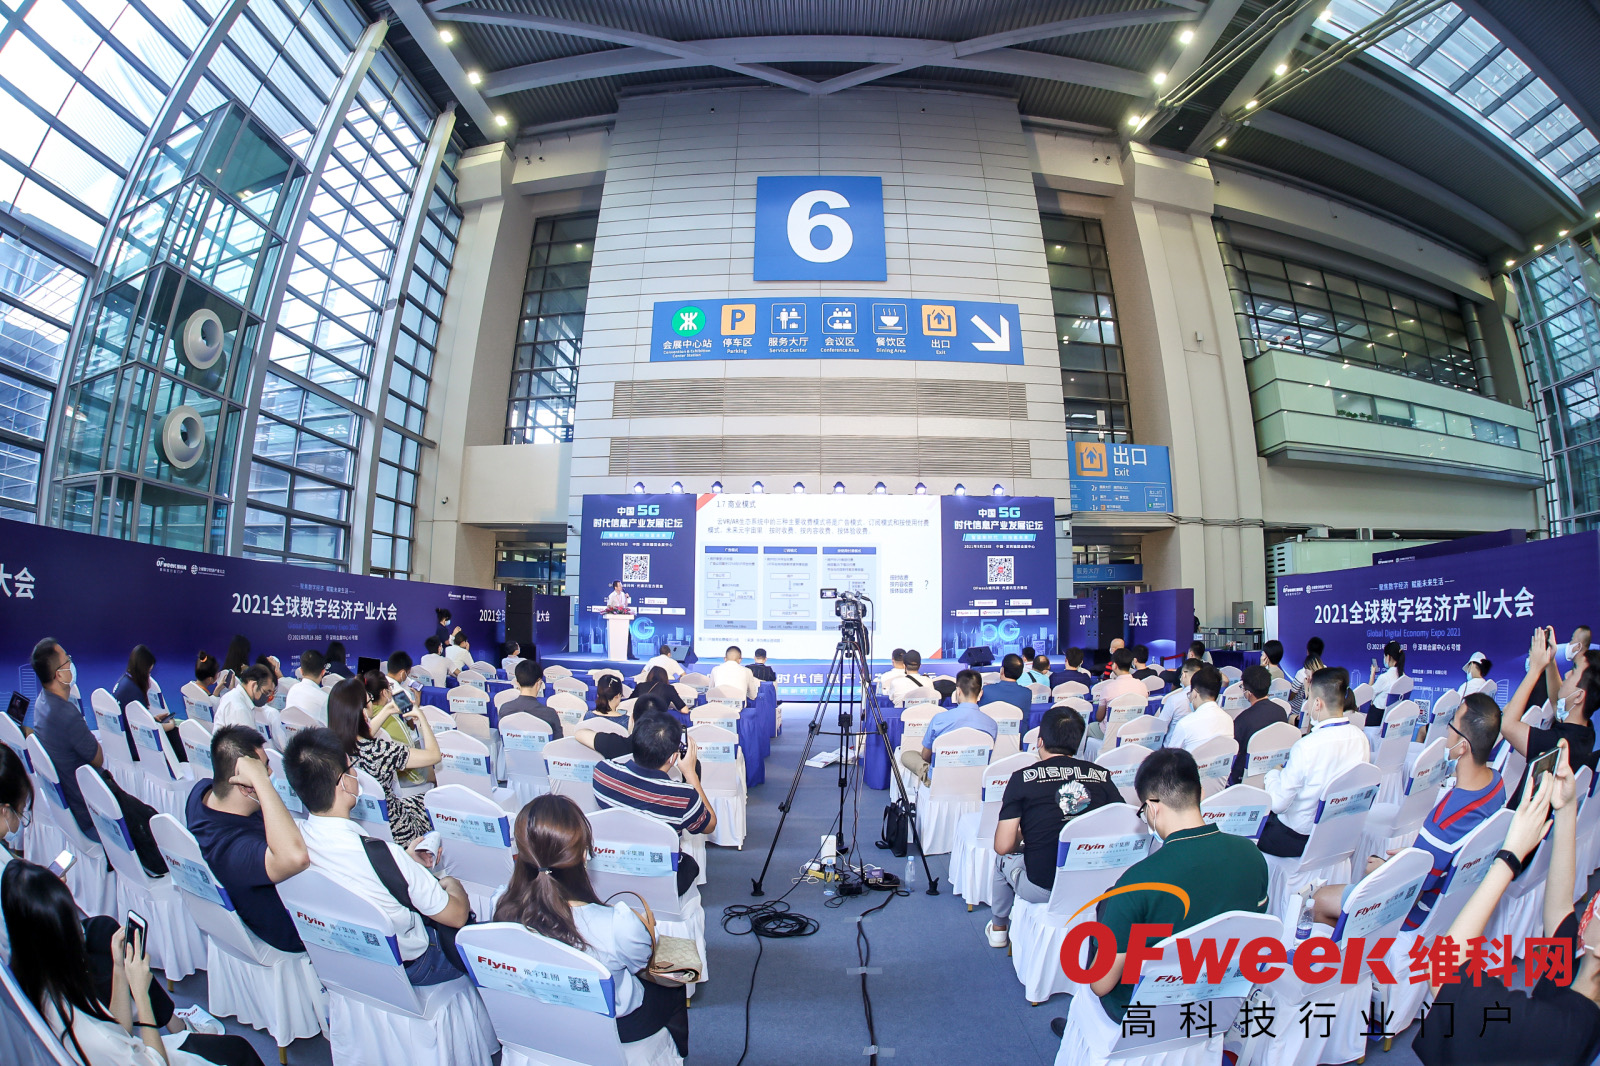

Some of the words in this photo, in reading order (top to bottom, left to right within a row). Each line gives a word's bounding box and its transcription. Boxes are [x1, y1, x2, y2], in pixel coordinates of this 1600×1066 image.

[787, 190, 853, 262] 6
[663, 339, 712, 350] 会展中心站
[723, 338, 752, 347] 停车区
[768, 337, 808, 346] 服务大厅
[825, 337, 855, 346] 会议区
[876, 337, 906, 346] 餐饮区
[931, 339, 950, 348] 出口
[1114, 446, 1147, 465] 出口
[1114, 468, 1130, 476] Exit
[617, 507, 634, 516] 中国
[638, 505, 660, 516] 5G
[978, 508, 996, 518] 中国
[998, 507, 1021, 518] 5G
[593, 518, 683, 528] 时代信息产业发展论坛
[954, 520, 1043, 530] 时代信息产业发展论坛
[1379, 582, 1409, 591] 聚焦数字经济
[1412, 577, 1444, 588] 赋能未来生活
[231, 592, 397, 621] 2021全球数字经济产业大会
[1314, 586, 1534, 625] 2021全球数字经济产业大会
[980, 618, 1020, 642] 5G
[1367, 629, 1383, 638] Global
[1385, 629, 1401, 639] Digital
[1403, 629, 1429, 639] Economy
[1430, 628, 1445, 638] Expo
[1446, 628, 1461, 636] 2021
[1023, 766, 1107, 782] DISPLAY
[1330, 796, 1348, 805] Flyin
[436, 813, 457, 822] Flyin
[1461, 857, 1481, 871] Flyin
[1355, 902, 1381, 918] Flyin
[297, 911, 325, 927] Flyin
[478, 956, 516, 972] Flyin
